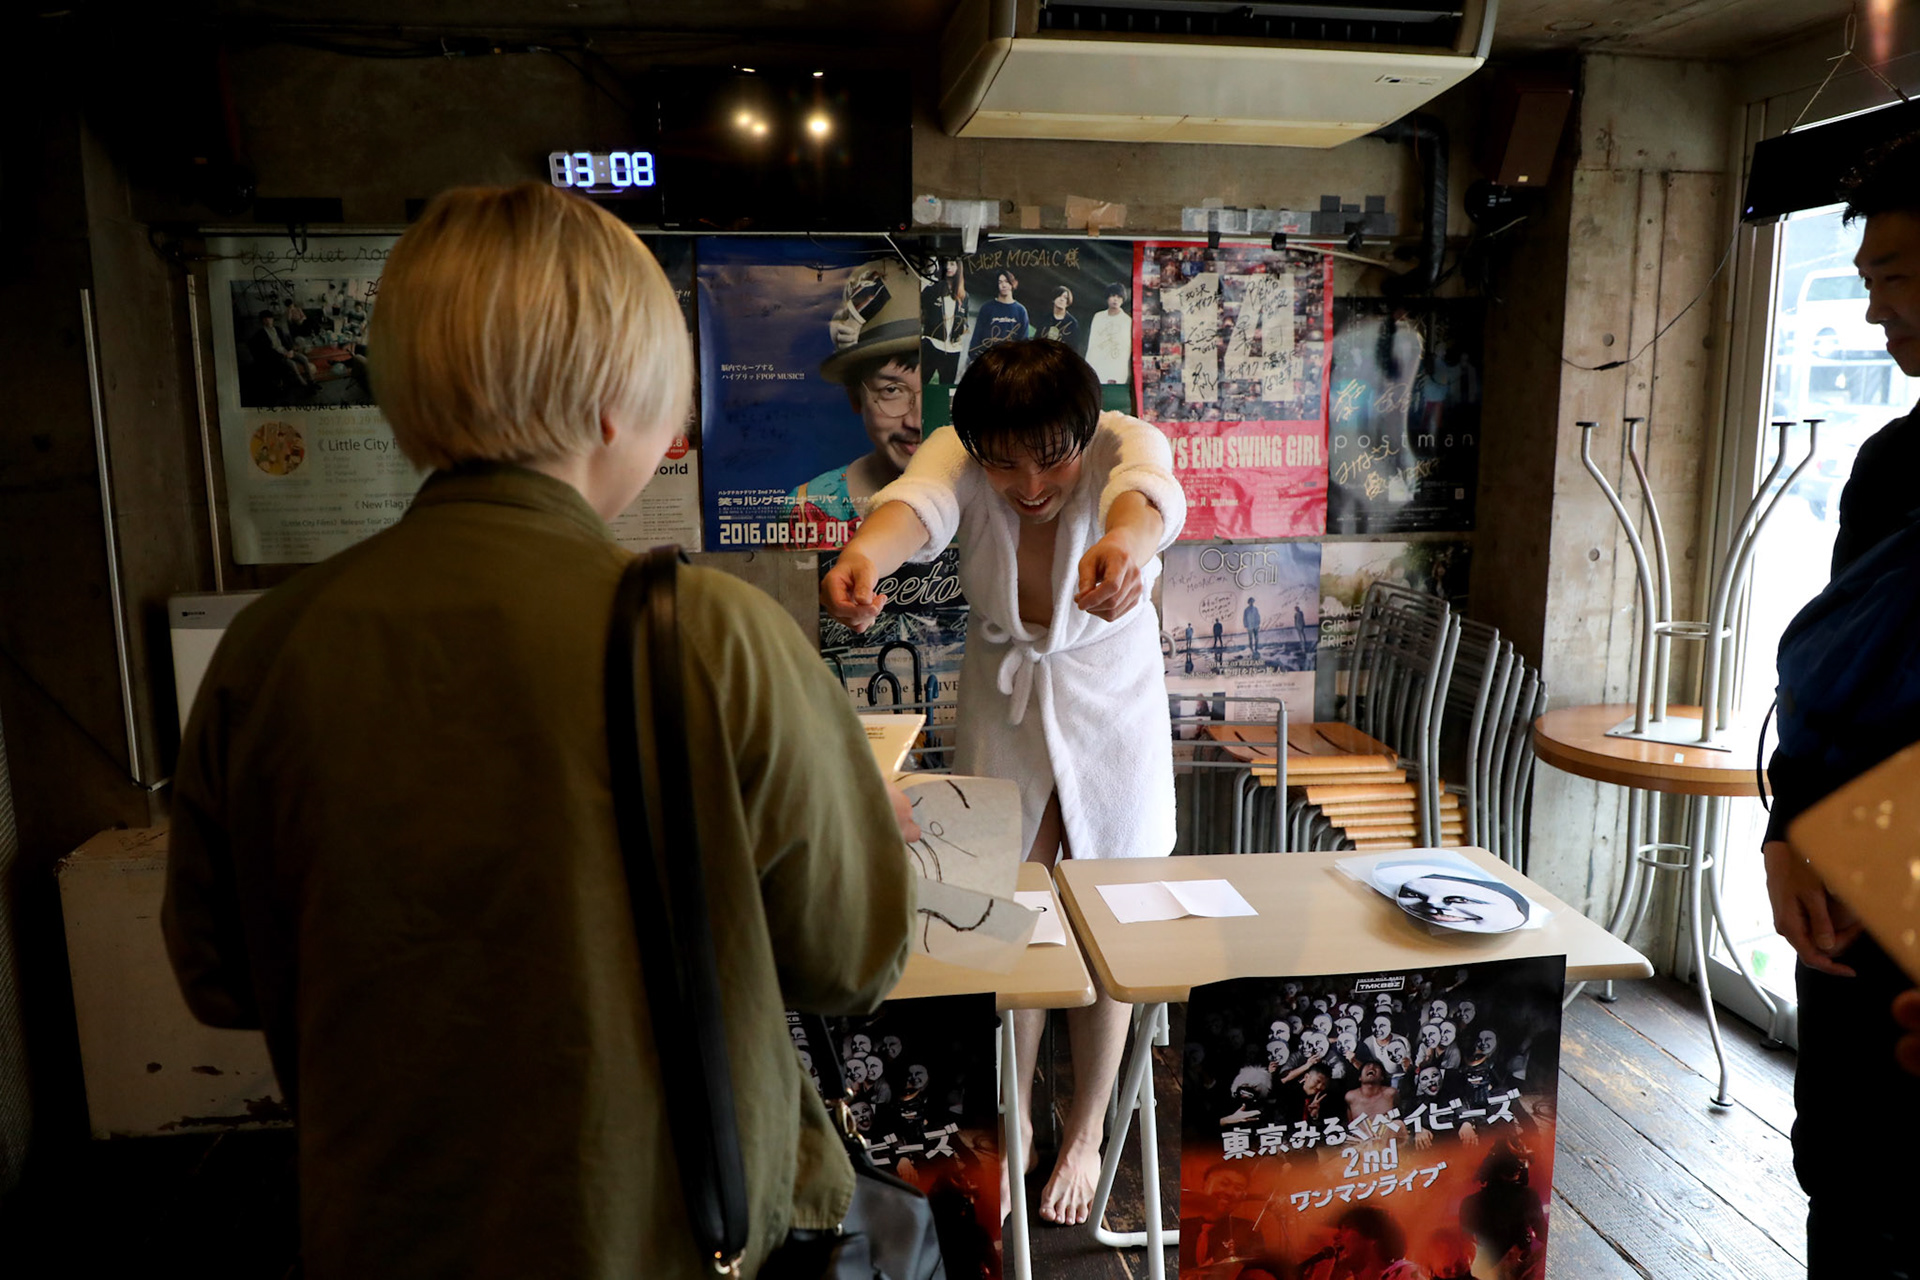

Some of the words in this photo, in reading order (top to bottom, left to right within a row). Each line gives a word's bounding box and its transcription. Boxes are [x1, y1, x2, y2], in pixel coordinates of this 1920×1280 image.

[563, 151, 654, 187] 13:08
[363, 438, 389, 453] City
[1192, 436, 1224, 469] END
[1227, 435, 1282, 469] SWING
[1286, 434, 1322, 467] GIRL
[1335, 433, 1474, 454] postman
[655, 464, 688, 475] orld
[719, 522, 818, 544] 2016.08.03
[1221, 1087, 1521, 1161] 東京みるくベイビーズ
[1341, 1138, 1399, 1179] 2nd
[1290, 1161, 1448, 1212] ワンマンライブ
